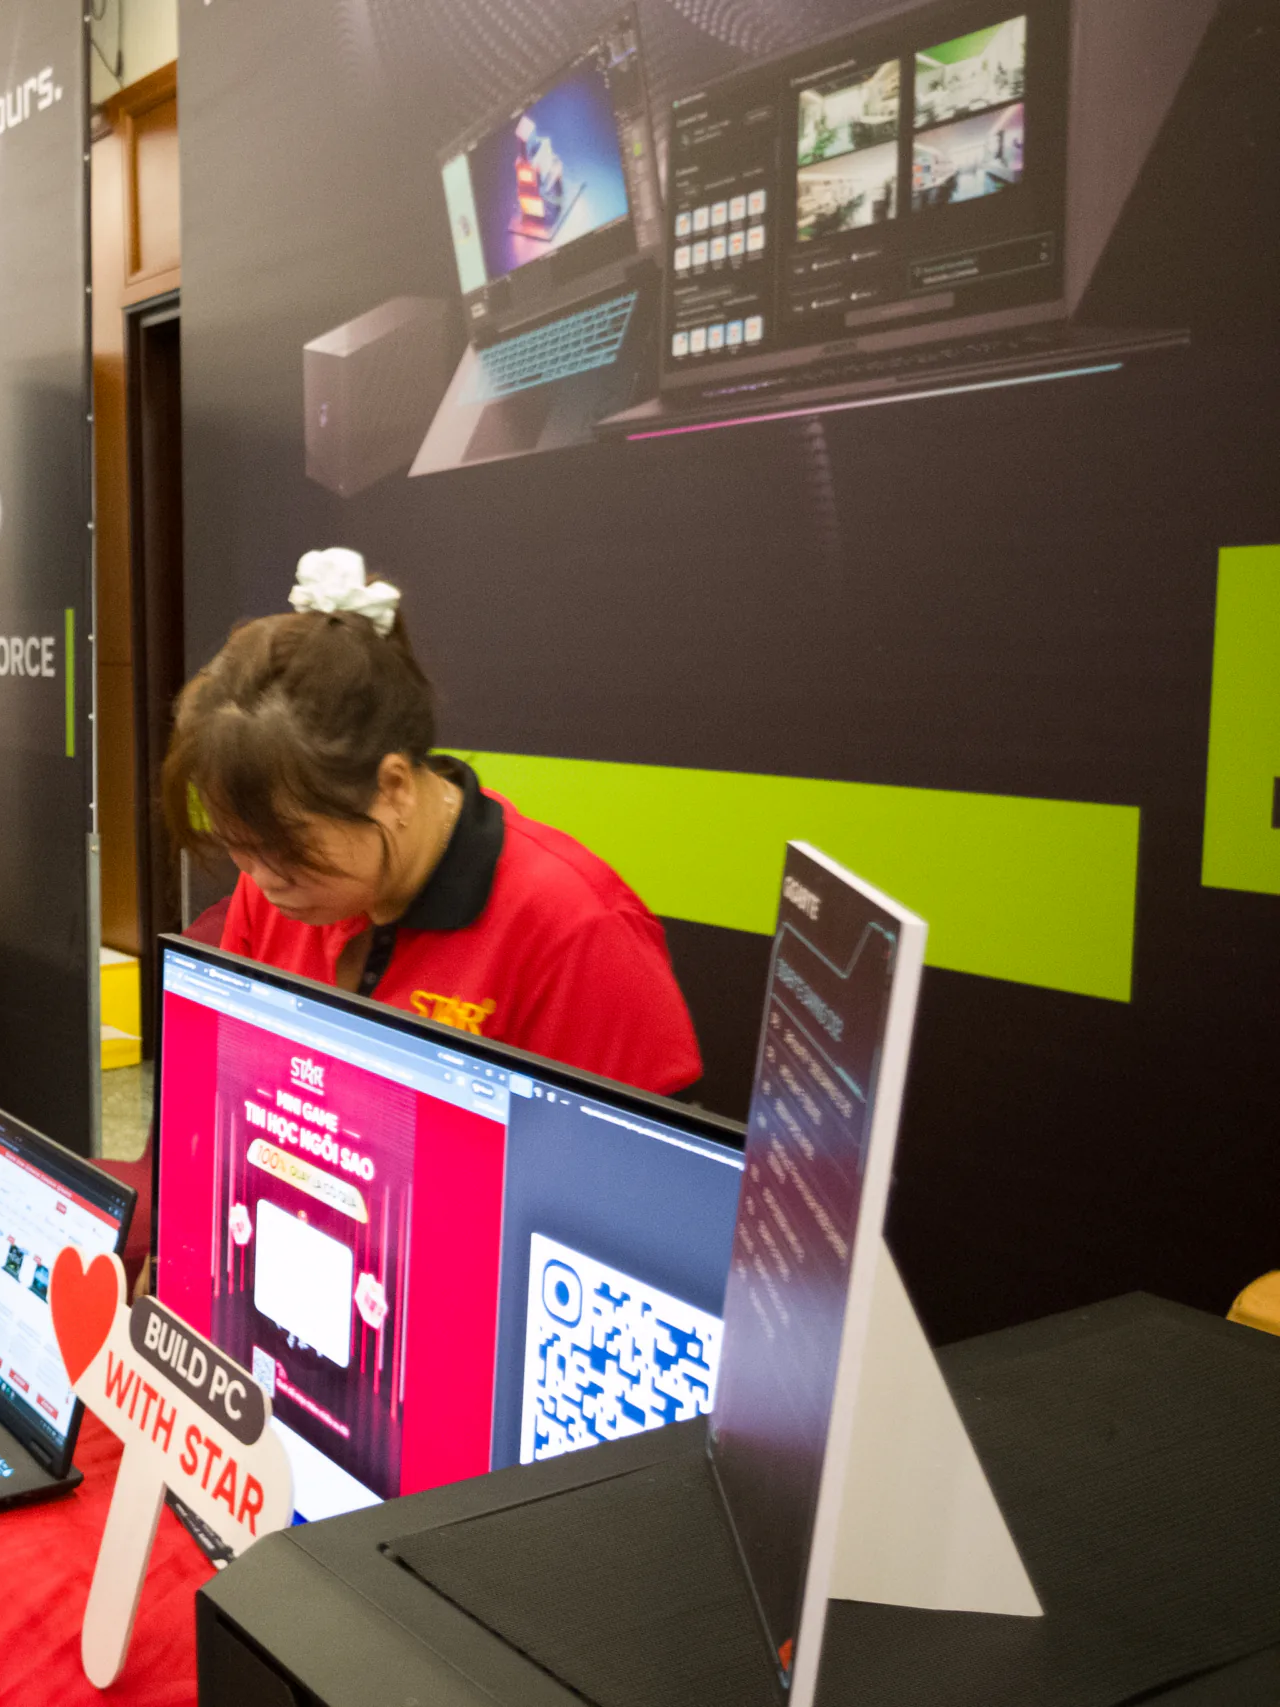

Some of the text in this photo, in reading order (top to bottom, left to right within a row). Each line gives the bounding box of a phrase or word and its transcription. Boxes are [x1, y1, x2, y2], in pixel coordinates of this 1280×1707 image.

[290, 1056, 325, 1088] STAR
[267, 1111, 299, 1144] HỌC
[300, 1127, 339, 1164] NGÔI
[340, 1147, 376, 1181] SAO
[302, 1102, 339, 1133] GAME
[144, 1312, 208, 1388] BUILD
[208, 1365, 247, 1420] PC
[104, 1350, 178, 1453] WITH
[179, 1423, 265, 1537] STAR
